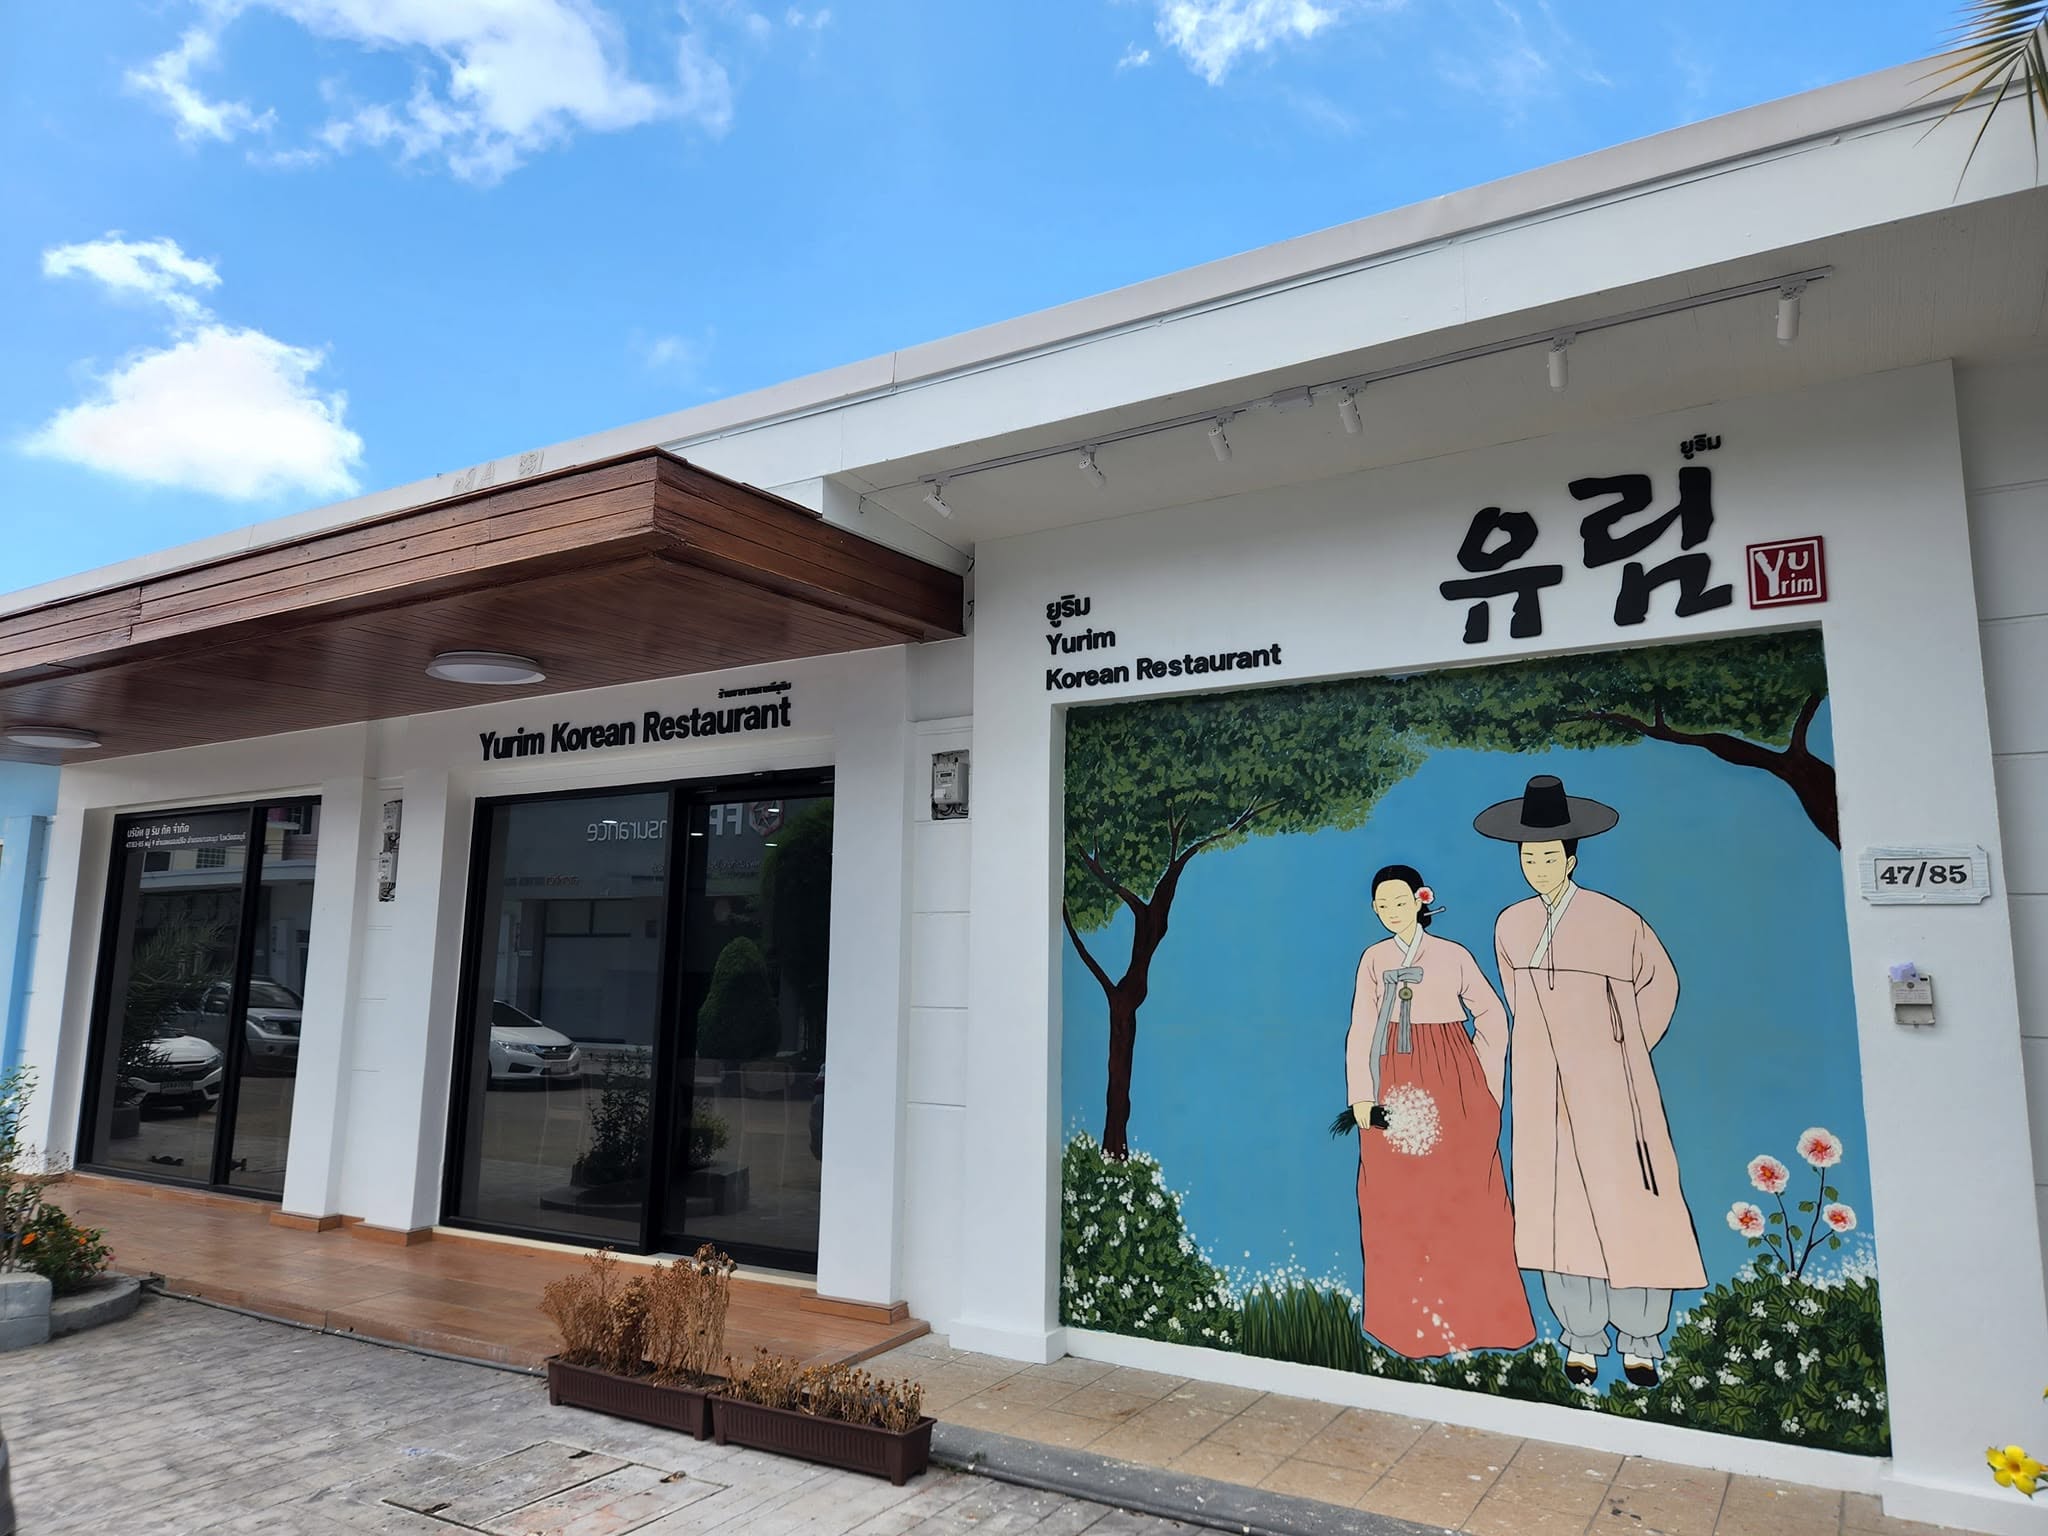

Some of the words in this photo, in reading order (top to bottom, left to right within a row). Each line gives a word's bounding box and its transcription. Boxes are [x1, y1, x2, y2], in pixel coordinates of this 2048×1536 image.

[1680, 433, 1722, 460] ยูริม
[1439, 466, 1734, 645] 유림
[1046, 594, 1091, 629] ยูริม
[1045, 627, 1116, 656] Yurim
[1045, 665, 1130, 691] Korean
[1136, 643, 1282, 681] Restaurant
[479, 727, 545, 761] Yurim
[550, 721, 636, 754] Korean
[642, 697, 792, 743] Restaurant
[1879, 861, 1968, 888] 47/85
